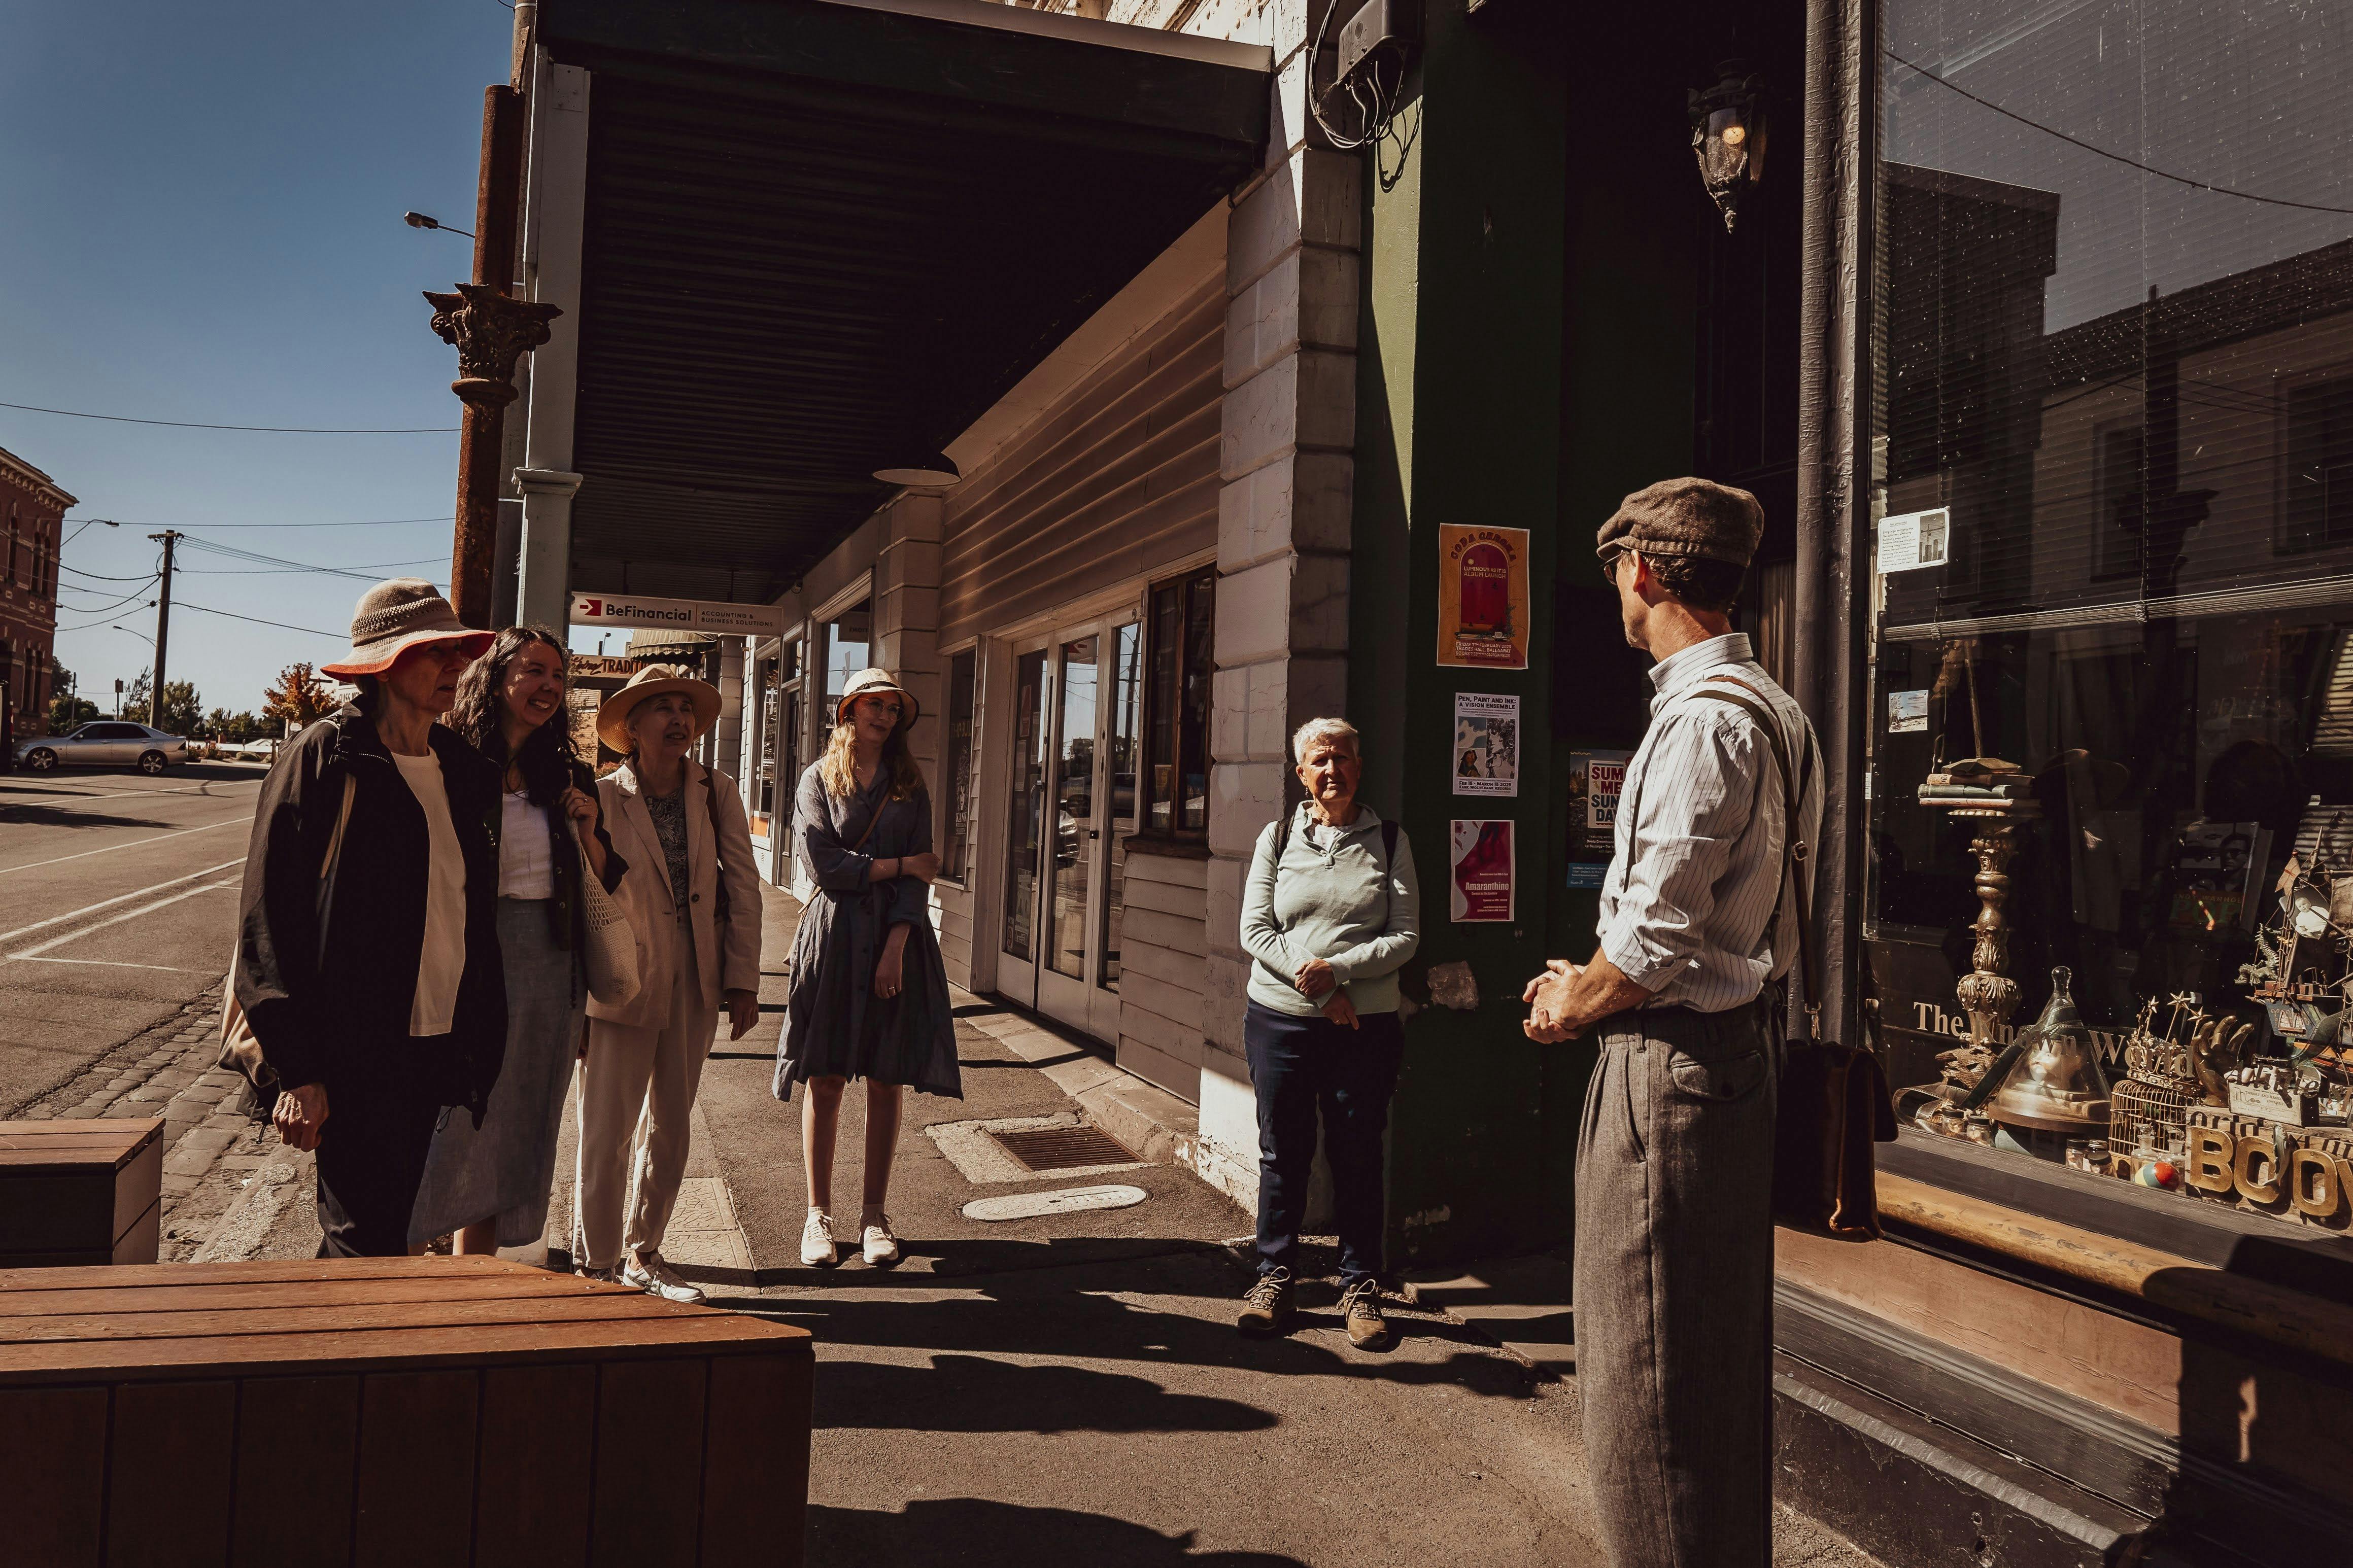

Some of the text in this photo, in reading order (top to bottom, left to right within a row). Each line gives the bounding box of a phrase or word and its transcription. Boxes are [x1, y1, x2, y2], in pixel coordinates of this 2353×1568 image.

[606, 604, 692, 621] BeFinancial
[1591, 766, 1624, 781] SUM
[1600, 781, 1622, 794] ME
[1591, 793, 1620, 808] SUN
[1465, 882, 1509, 890] Amaranthine
[1914, 1001, 2196, 1078] The Known World
